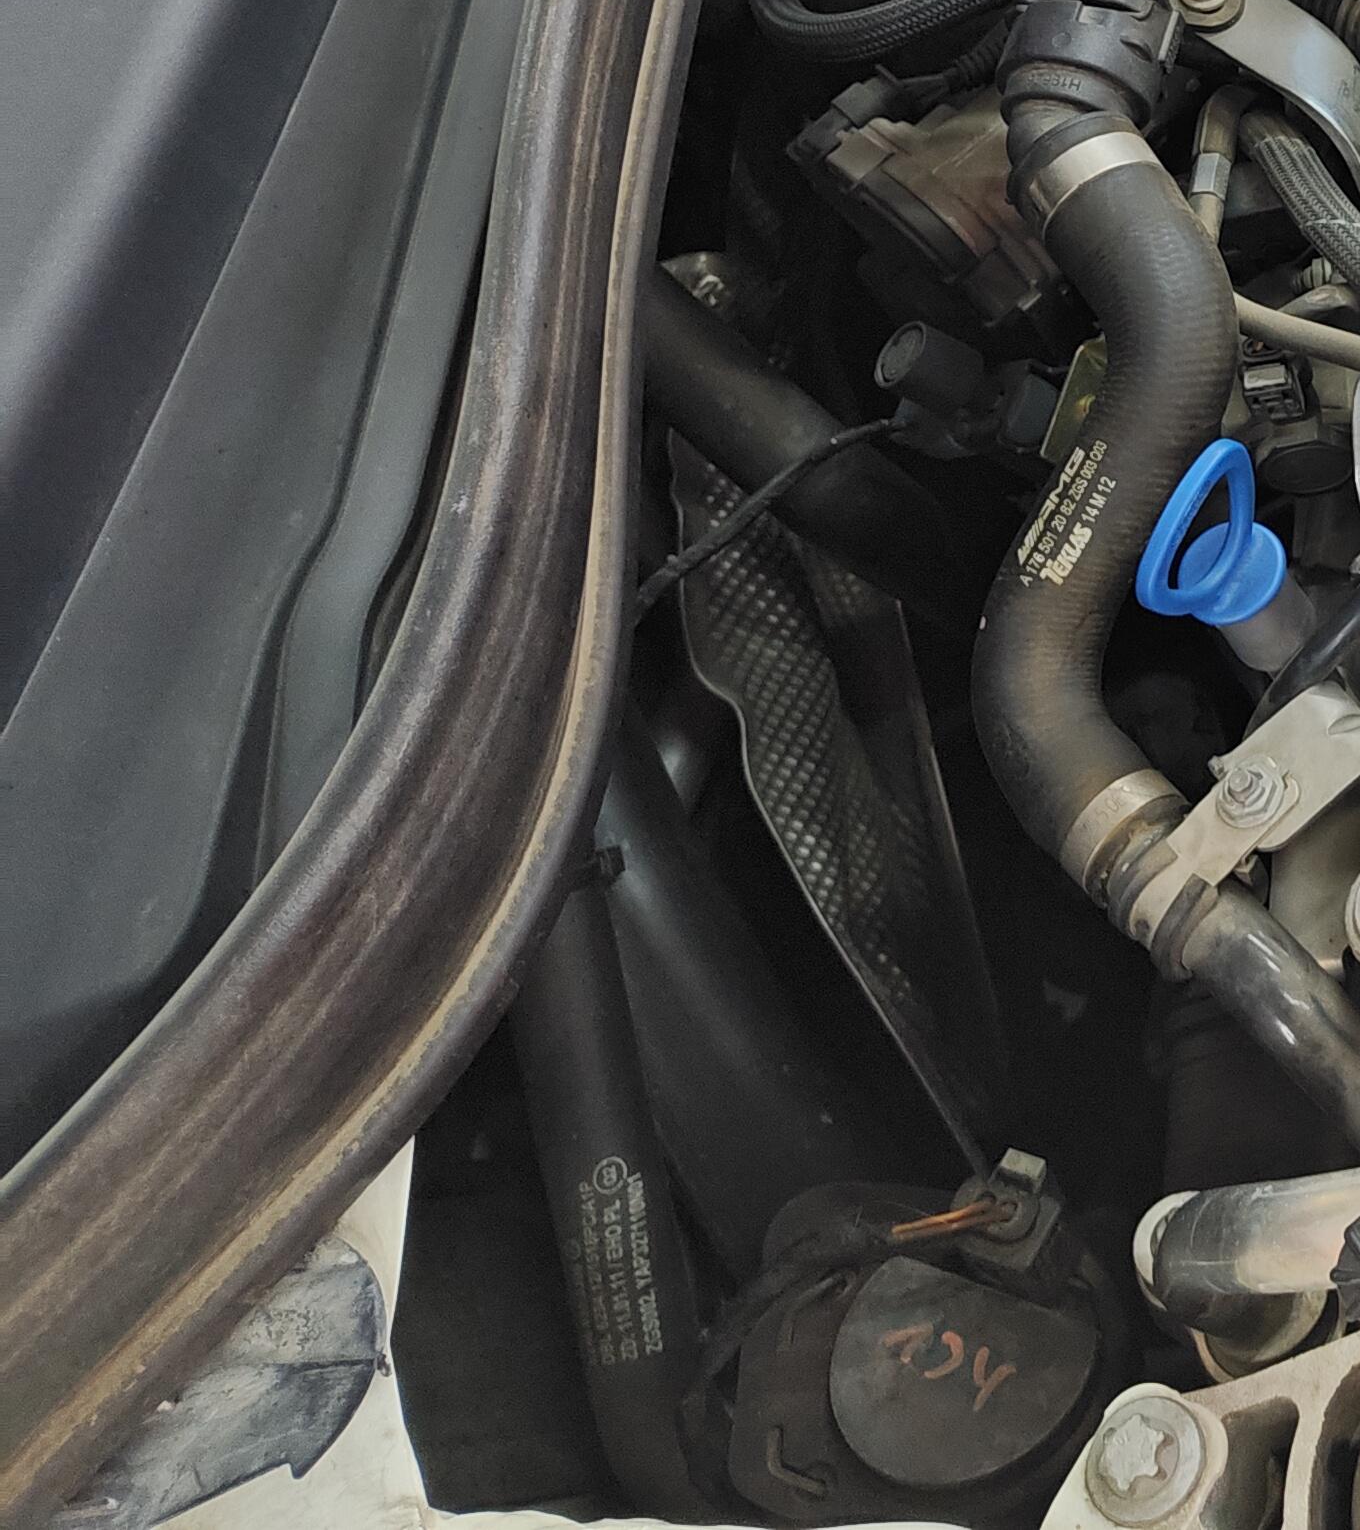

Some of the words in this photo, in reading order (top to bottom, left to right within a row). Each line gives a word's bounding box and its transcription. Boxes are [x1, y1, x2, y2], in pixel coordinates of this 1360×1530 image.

[1065, 475, 1089, 502] ZGS
[1039, 521, 1093, 587] TEKLAS
[1079, 503, 1101, 525] 14
[1094, 472, 1118, 496] 12
[1048, 512, 1069, 533] 20
[1036, 529, 1059, 555] 501
[1023, 550, 1047, 576] 176
[1018, 572, 1034, 587] A
